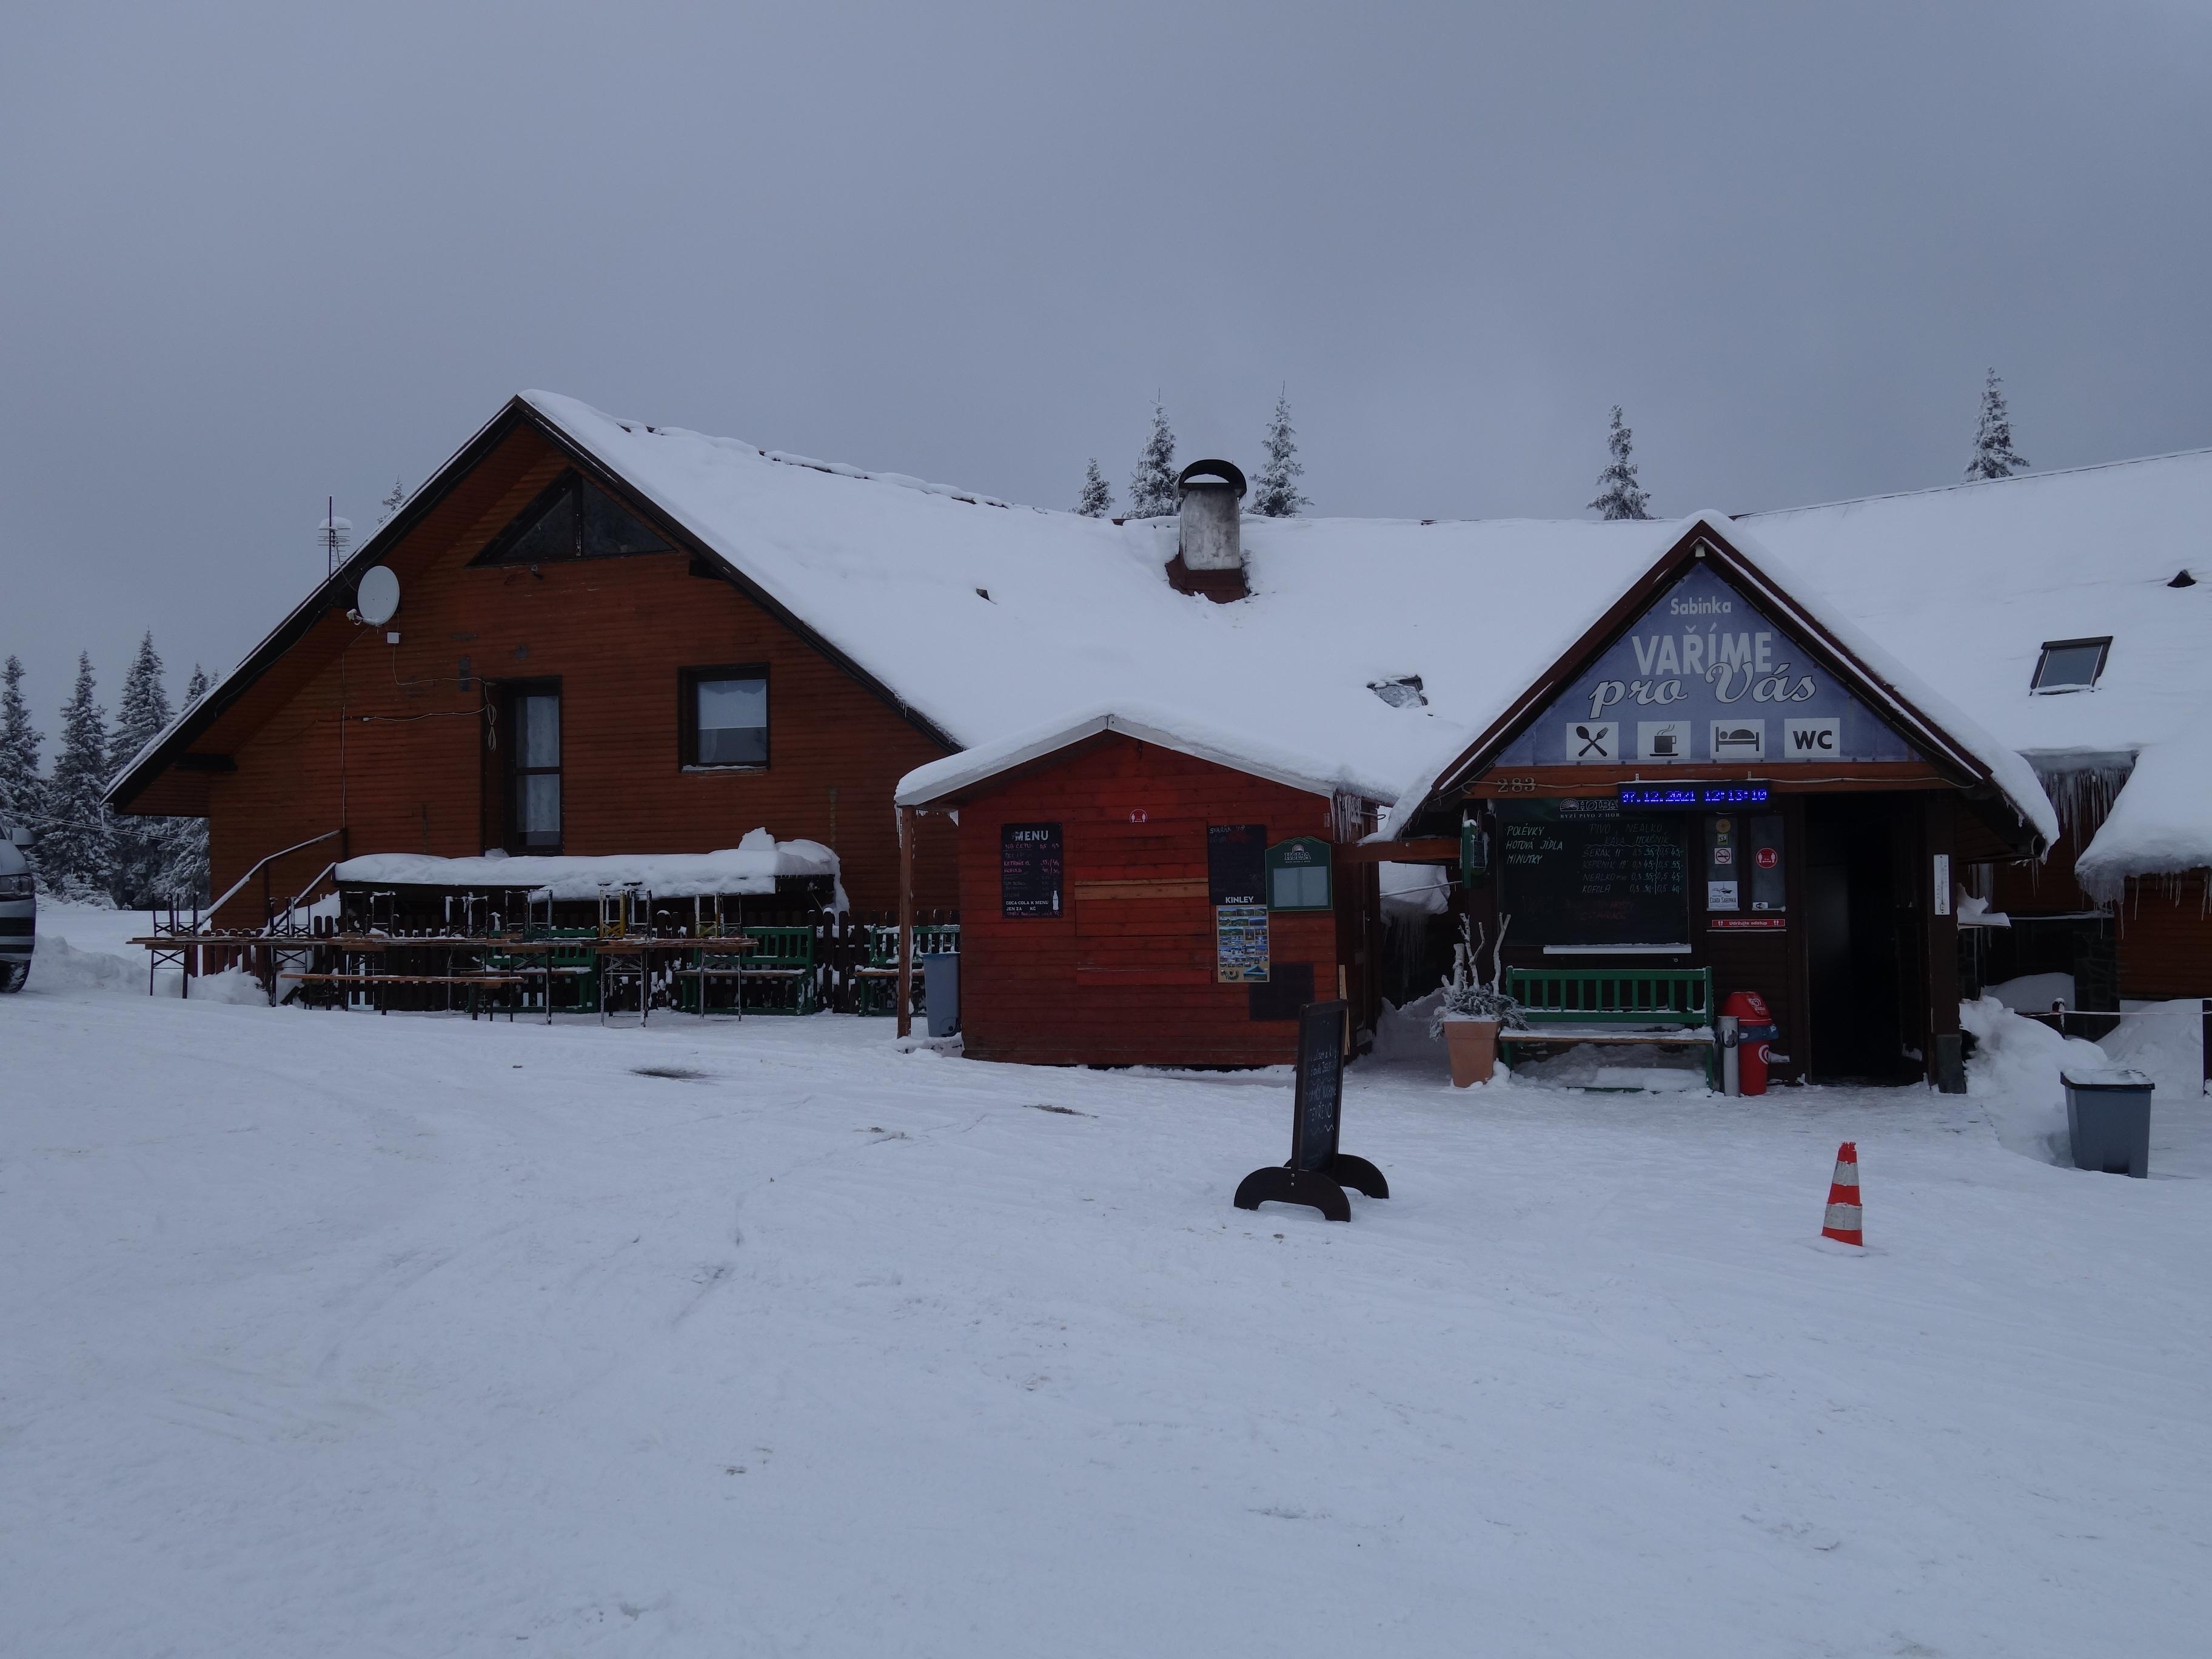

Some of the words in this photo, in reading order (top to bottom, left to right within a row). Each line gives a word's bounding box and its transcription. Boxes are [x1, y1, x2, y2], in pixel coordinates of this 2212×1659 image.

[1670, 596, 1731, 615] Sabinka
[1632, 624, 1772, 676] VAŘÍME
[1589, 675, 1688, 720] pro
[1704, 662, 1817, 703] Vás
[1792, 729, 1833, 751] WC
[1497, 777, 1536, 793] 283
[1577, 799, 1619, 812] HOLBA
[1014, 830, 1049, 842] MENU
[1506, 822, 1545, 836] POLÉVKY
[1505, 837, 1535, 850] HOTOVÁ
[1540, 836, 1563, 851] JÍDLA
[1284, 852, 1311, 860] HOLBA
[1506, 853, 1544, 865] MINUTKY
[1582, 884, 1611, 893] KOFOLA
